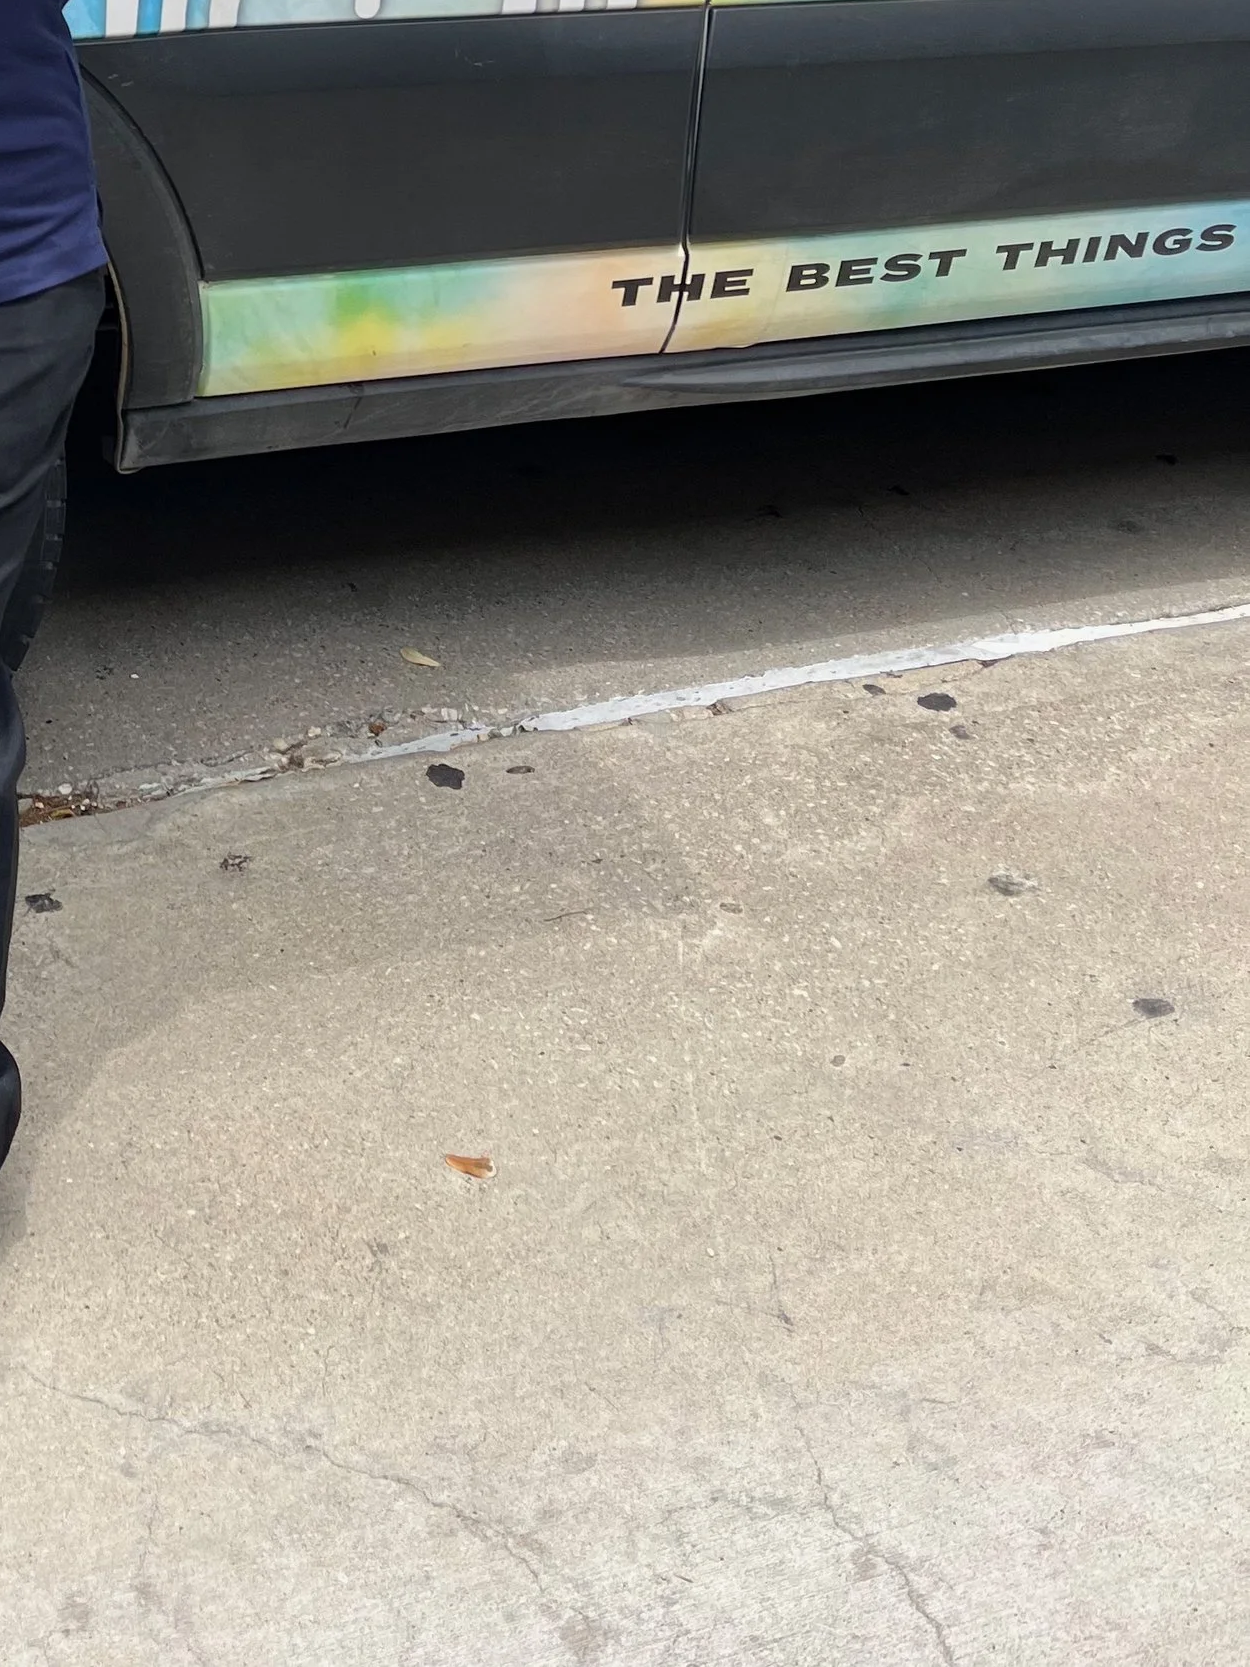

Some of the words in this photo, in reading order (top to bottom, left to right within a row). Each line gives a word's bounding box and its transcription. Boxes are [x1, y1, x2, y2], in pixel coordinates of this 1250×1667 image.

[611, 267, 754, 308] THE
[784, 248, 968, 294] BEST
[994, 223, 1238, 272] THINGS
